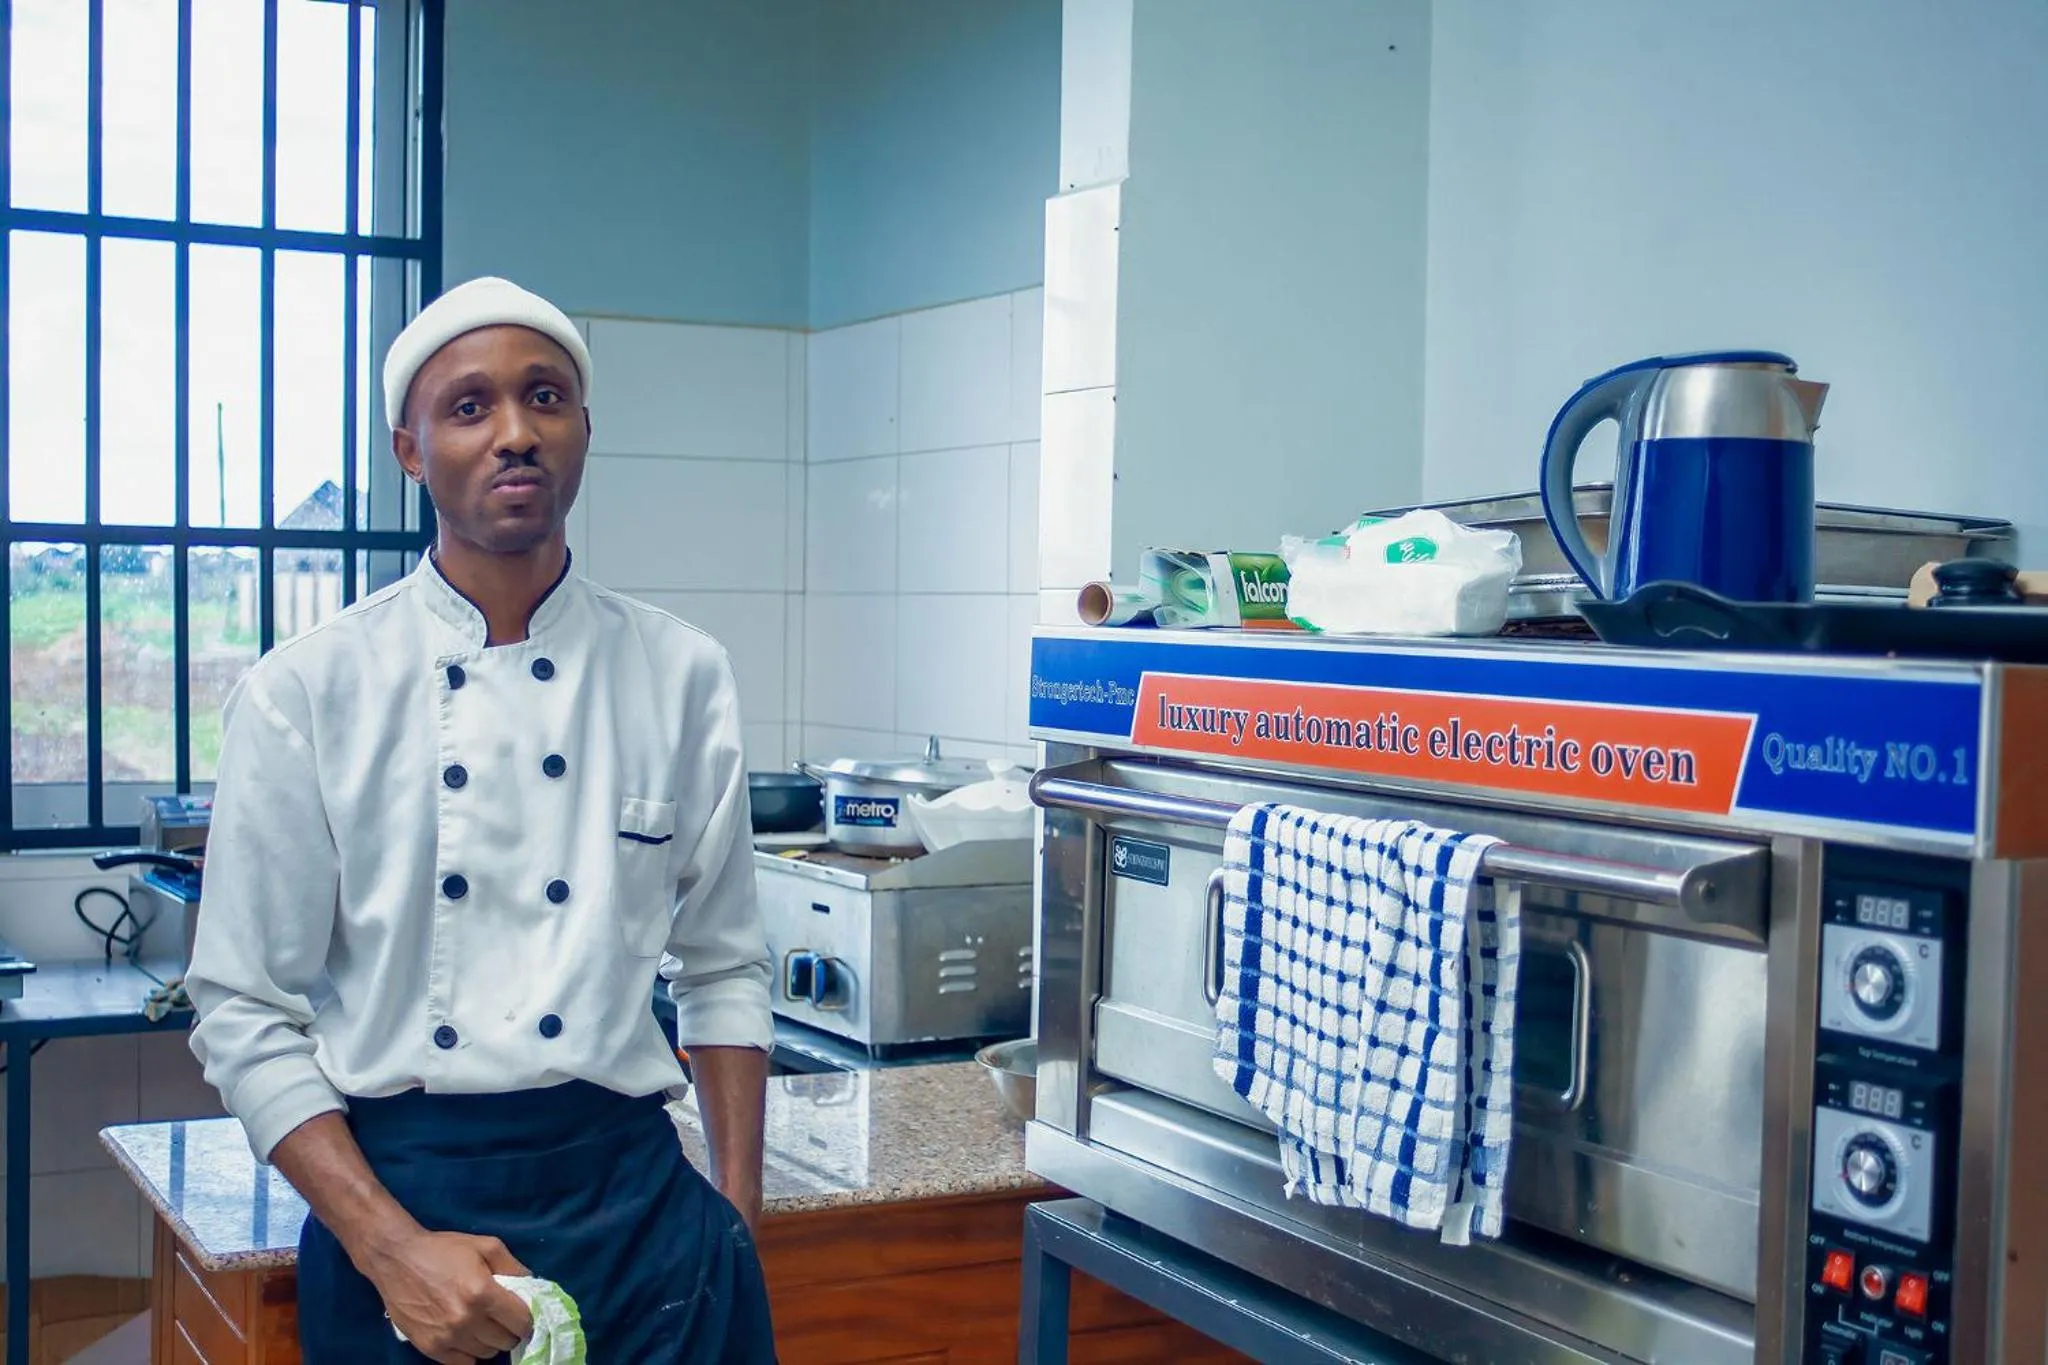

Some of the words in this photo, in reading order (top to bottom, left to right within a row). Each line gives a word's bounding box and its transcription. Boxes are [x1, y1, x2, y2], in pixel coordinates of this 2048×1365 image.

[1158, 693, 1249, 746] luxury
[1255, 702, 1419, 754] automatic
[1428, 717, 1582, 773] electric
[1590, 741, 1698, 787] oven
[1762, 732, 1878, 784] Quality
[846, 801, 895, 818] metro
